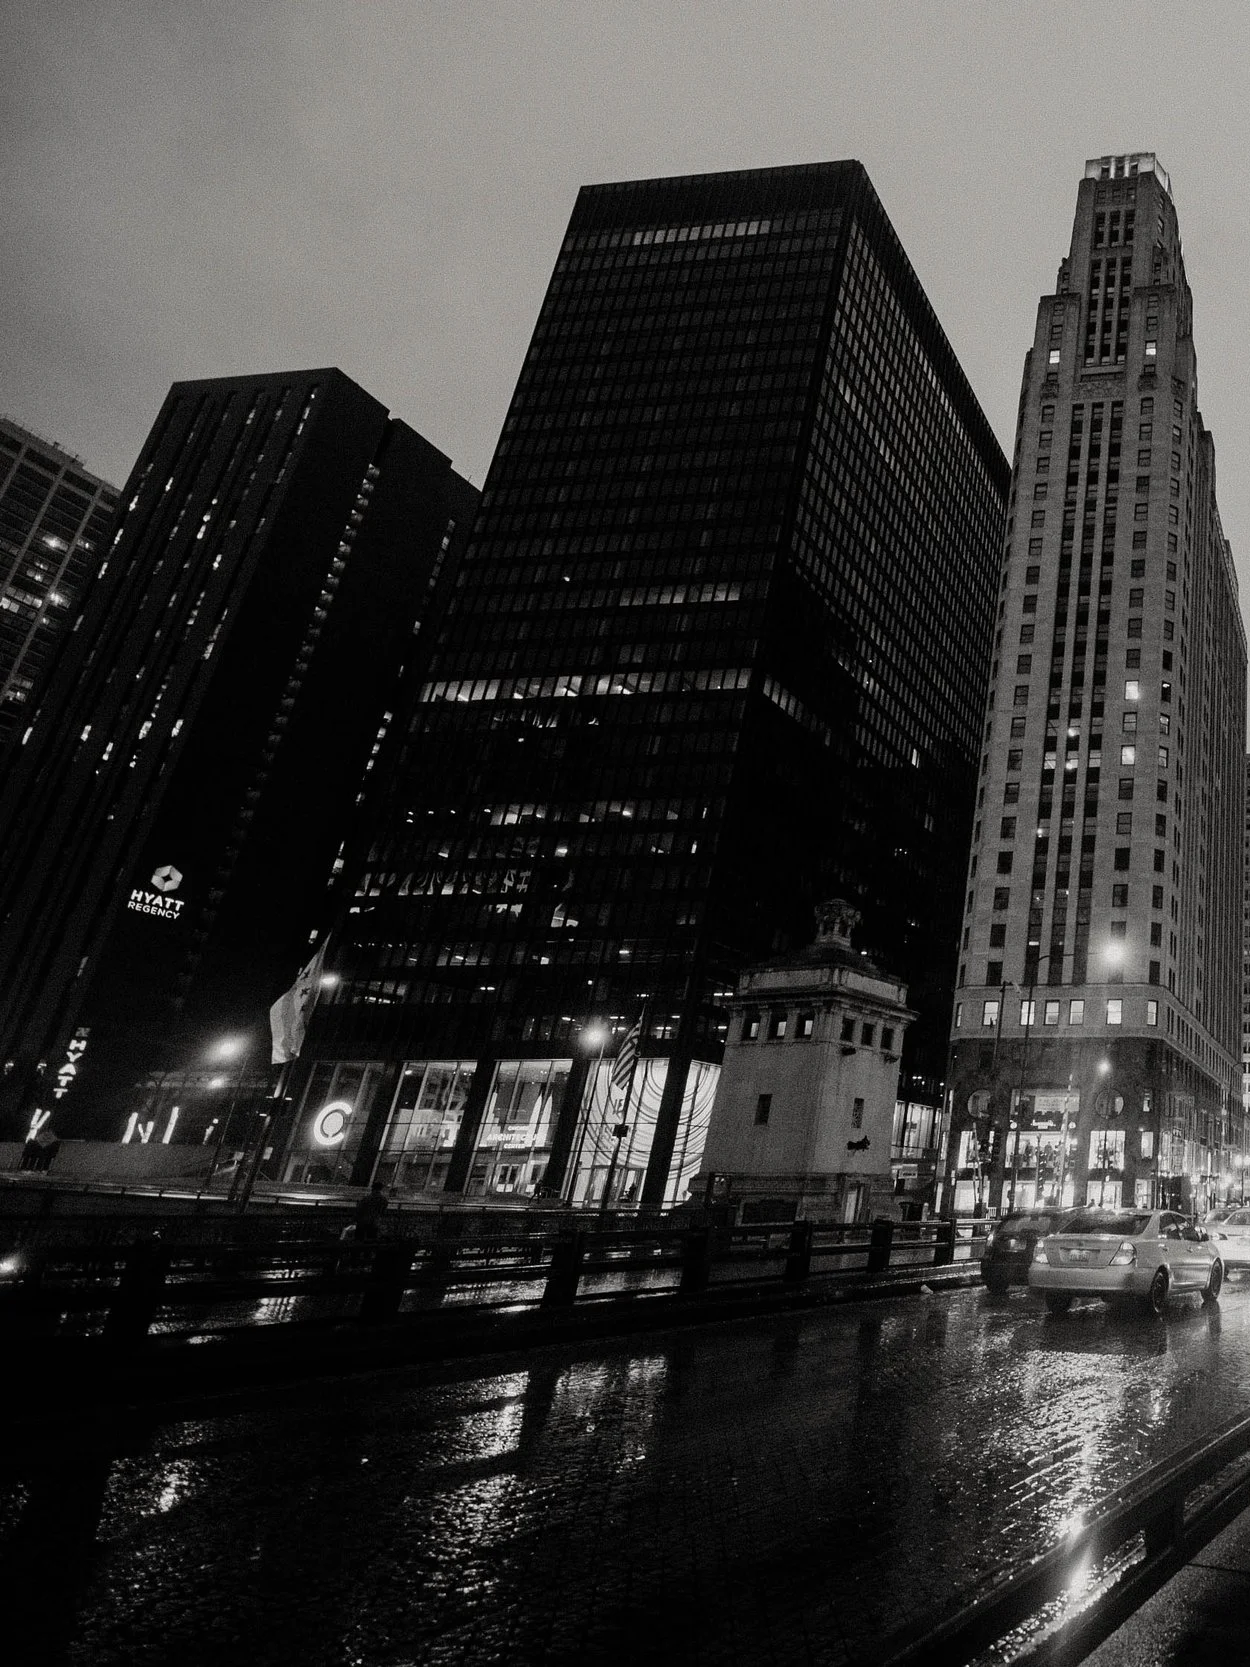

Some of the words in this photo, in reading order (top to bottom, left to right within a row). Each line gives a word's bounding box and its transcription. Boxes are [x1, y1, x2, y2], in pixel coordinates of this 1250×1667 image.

[127, 900, 180, 920] REGENCY
[130, 889, 185, 912] HYATT
[53, 1039, 87, 1098] HYATT
